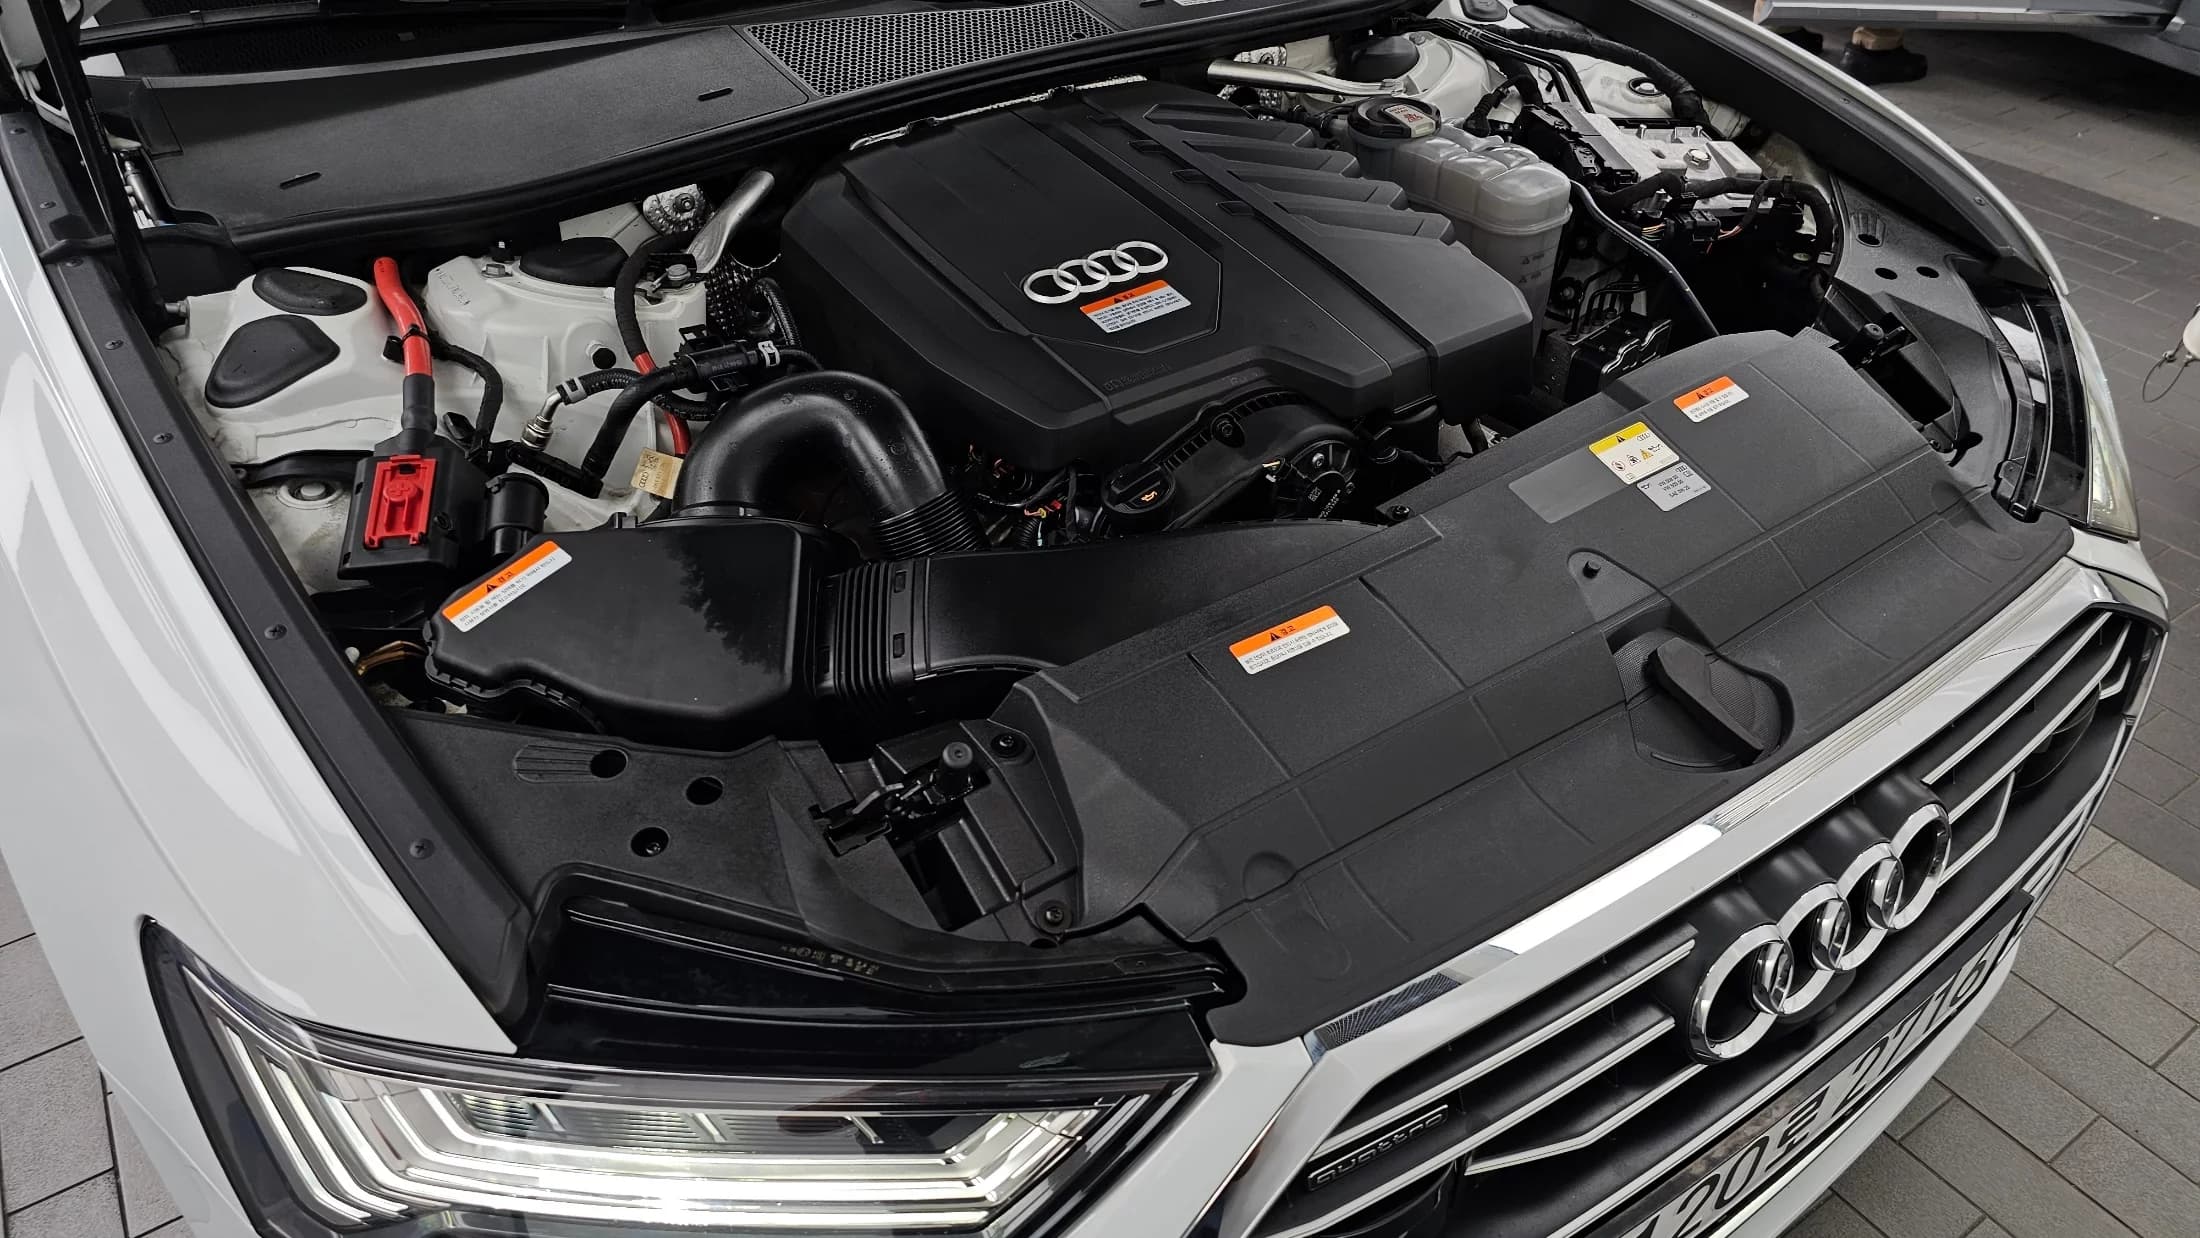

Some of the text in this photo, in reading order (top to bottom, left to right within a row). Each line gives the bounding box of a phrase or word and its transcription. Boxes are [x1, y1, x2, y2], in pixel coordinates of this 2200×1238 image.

[1315, 1112, 1444, 1184] quattro
[1636, 934, 2000, 1238] 20로 2716
